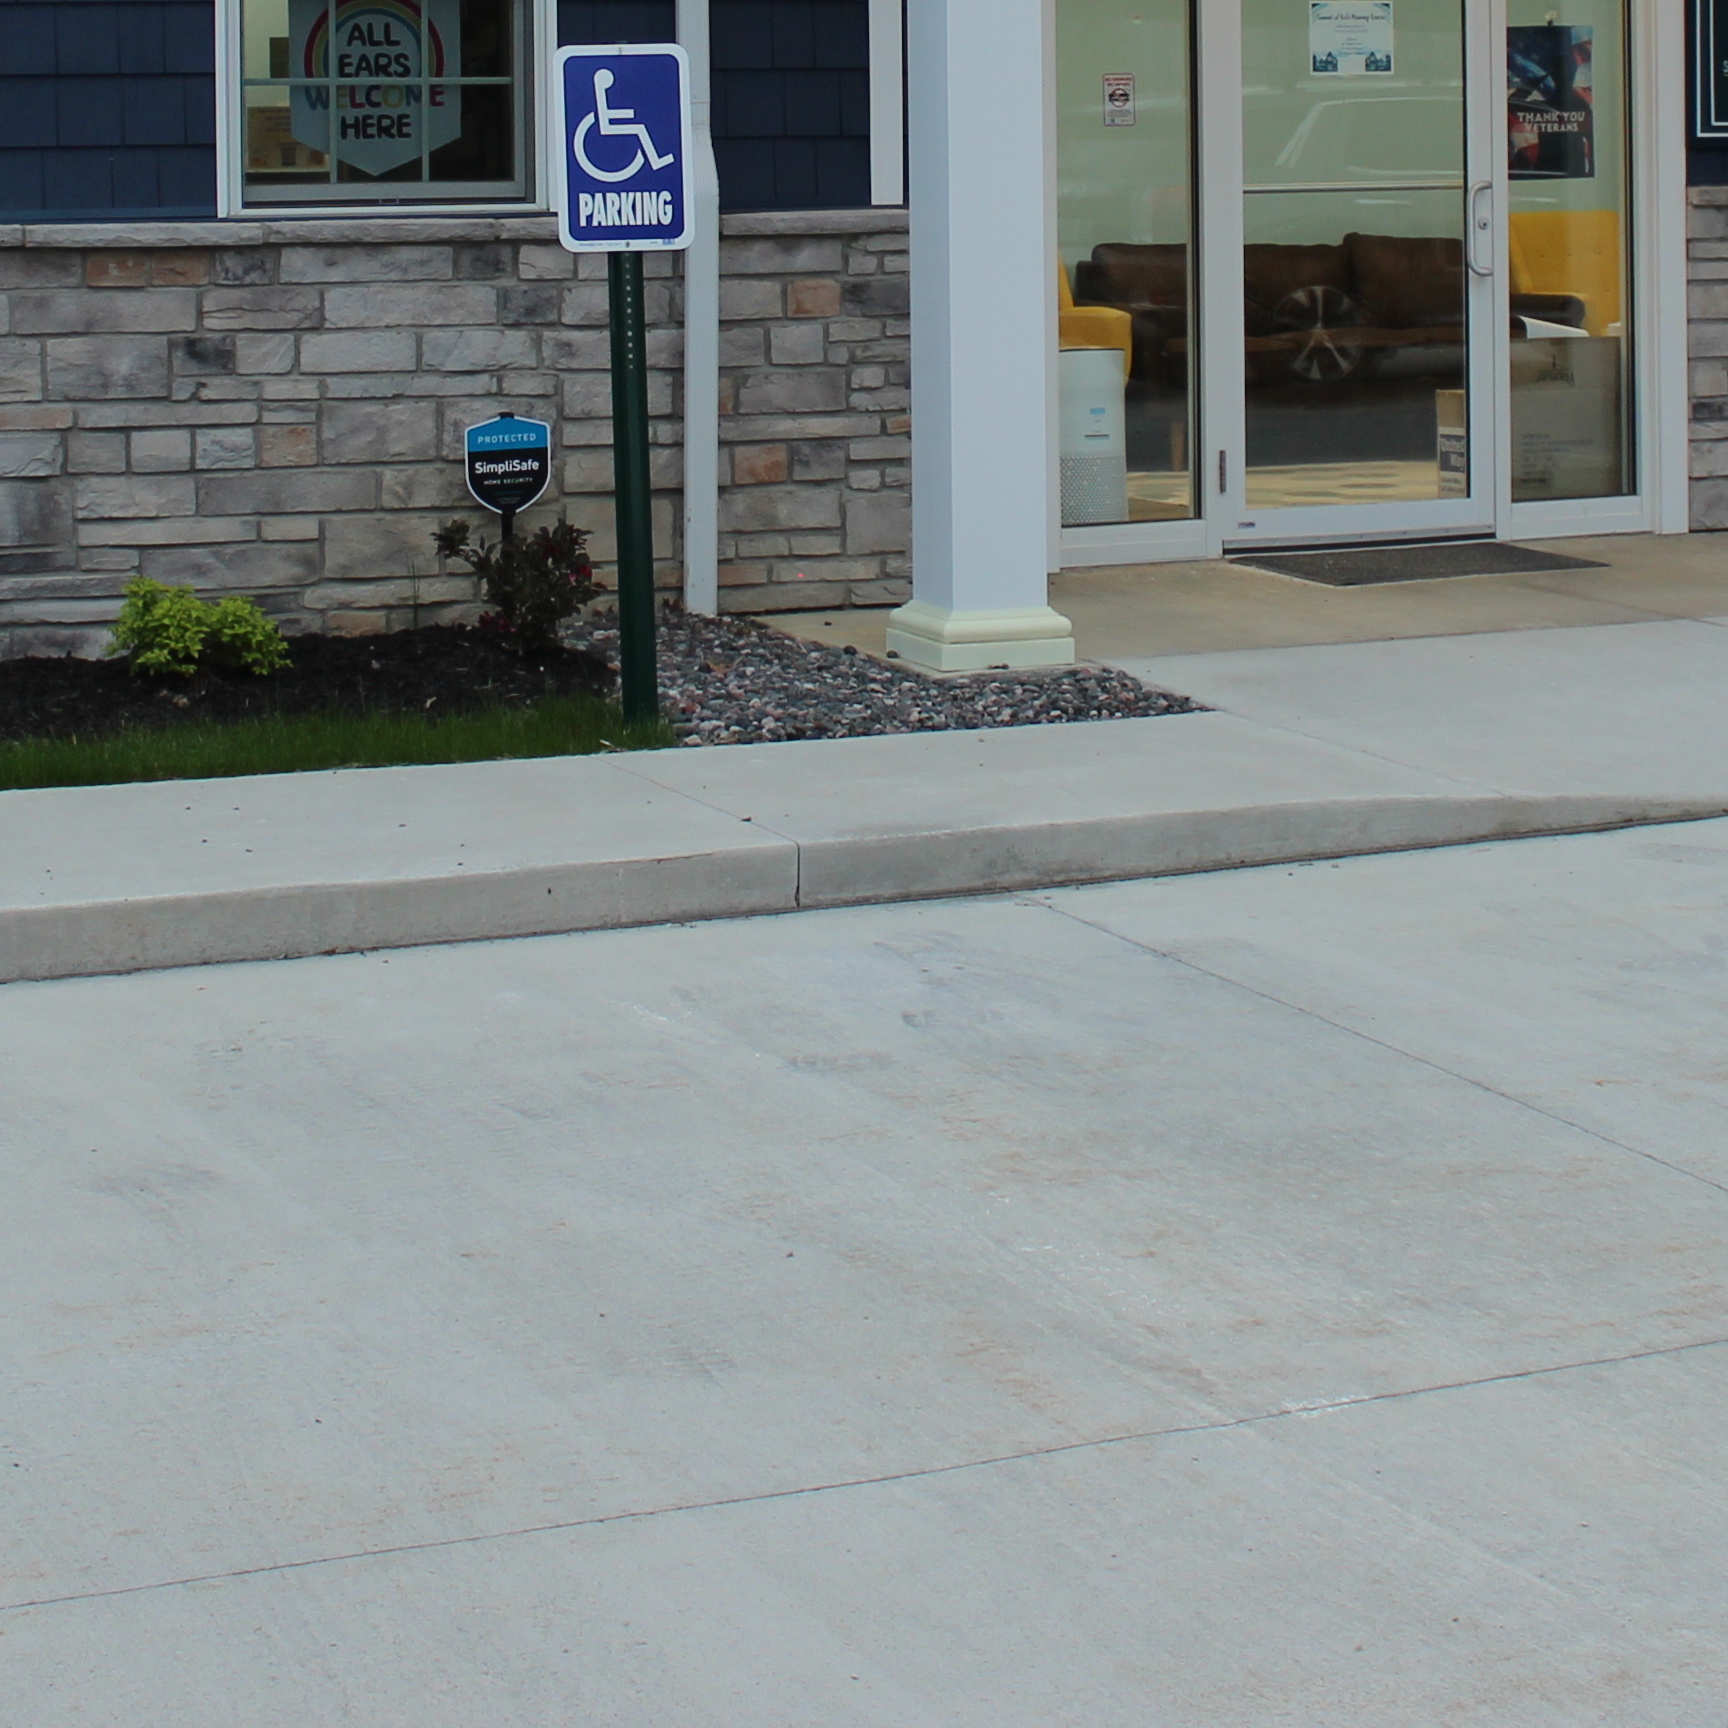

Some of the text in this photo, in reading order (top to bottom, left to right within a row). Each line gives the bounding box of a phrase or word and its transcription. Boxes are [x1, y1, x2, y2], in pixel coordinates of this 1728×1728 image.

[346, 22, 401, 47] ALL
[338, 52, 412, 78] EARS
[340, 113, 412, 140] HERE
[1517, 111, 1586, 122] THANK YOU
[1524, 123, 1579, 133] VETERANS
[578, 190, 673, 227] PARKING
[477, 433, 537, 444] PROTECTED
[474, 458, 540, 475] SimpliSafe
